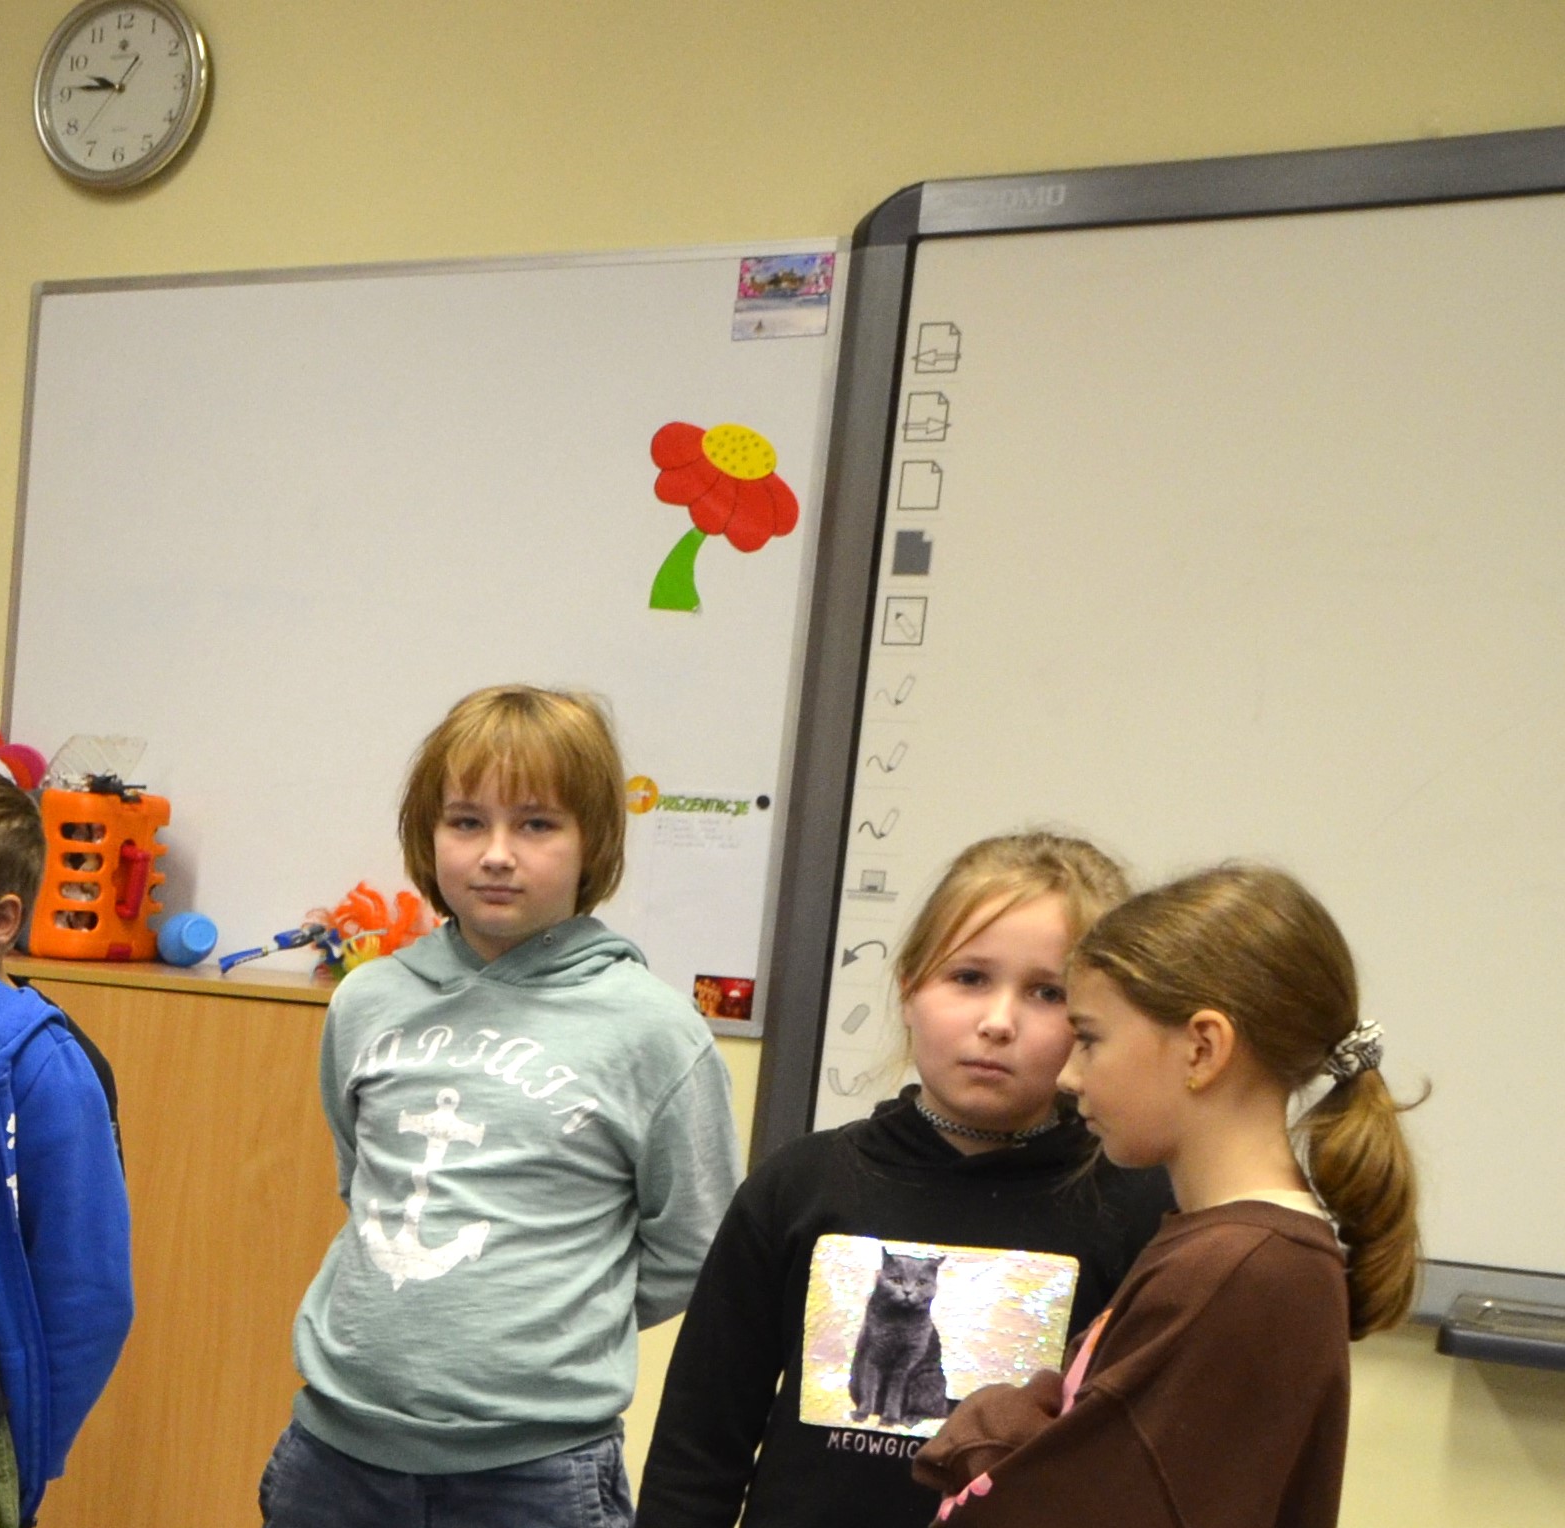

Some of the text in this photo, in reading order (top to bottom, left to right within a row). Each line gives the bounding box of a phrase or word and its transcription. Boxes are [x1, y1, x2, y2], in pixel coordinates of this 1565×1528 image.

[118, 13, 135, 30] 12
[151, 18, 157, 34] 1
[91, 27, 104, 44] 11
[168, 40, 180, 57] 2
[69, 55, 88, 72] 10
[174, 73, 186, 91] 3
[59, 87, 72, 103] 9
[163, 110, 176, 124] 4
[66, 119, 79, 136] 8
[86, 141, 97, 158] 7
[141, 134, 153, 152] 5
[112, 147, 125, 163] 6
